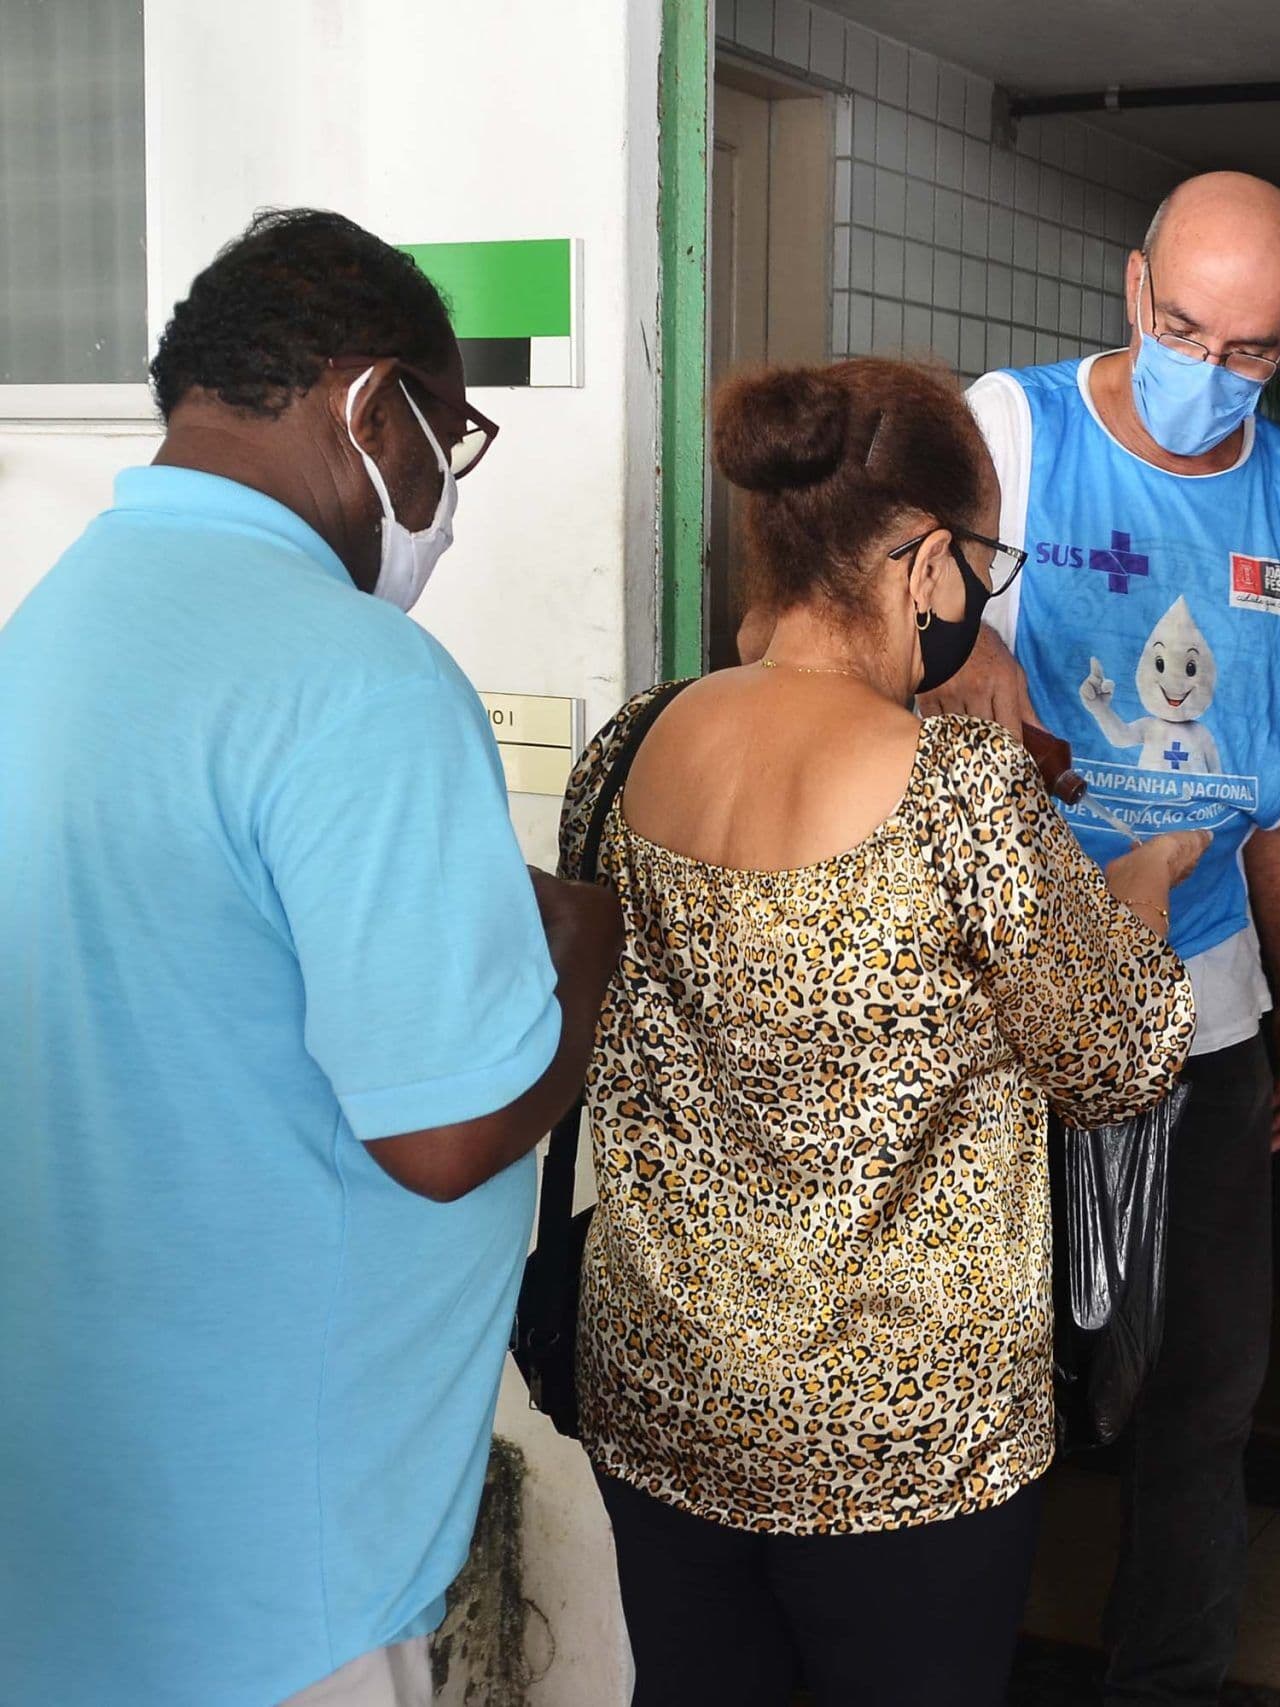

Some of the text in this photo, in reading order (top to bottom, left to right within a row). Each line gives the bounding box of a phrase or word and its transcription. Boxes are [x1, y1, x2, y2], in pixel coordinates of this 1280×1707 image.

[1036, 542, 1083, 568] SUS
[1074, 768, 1254, 801] AMPANHA NACIONAL
